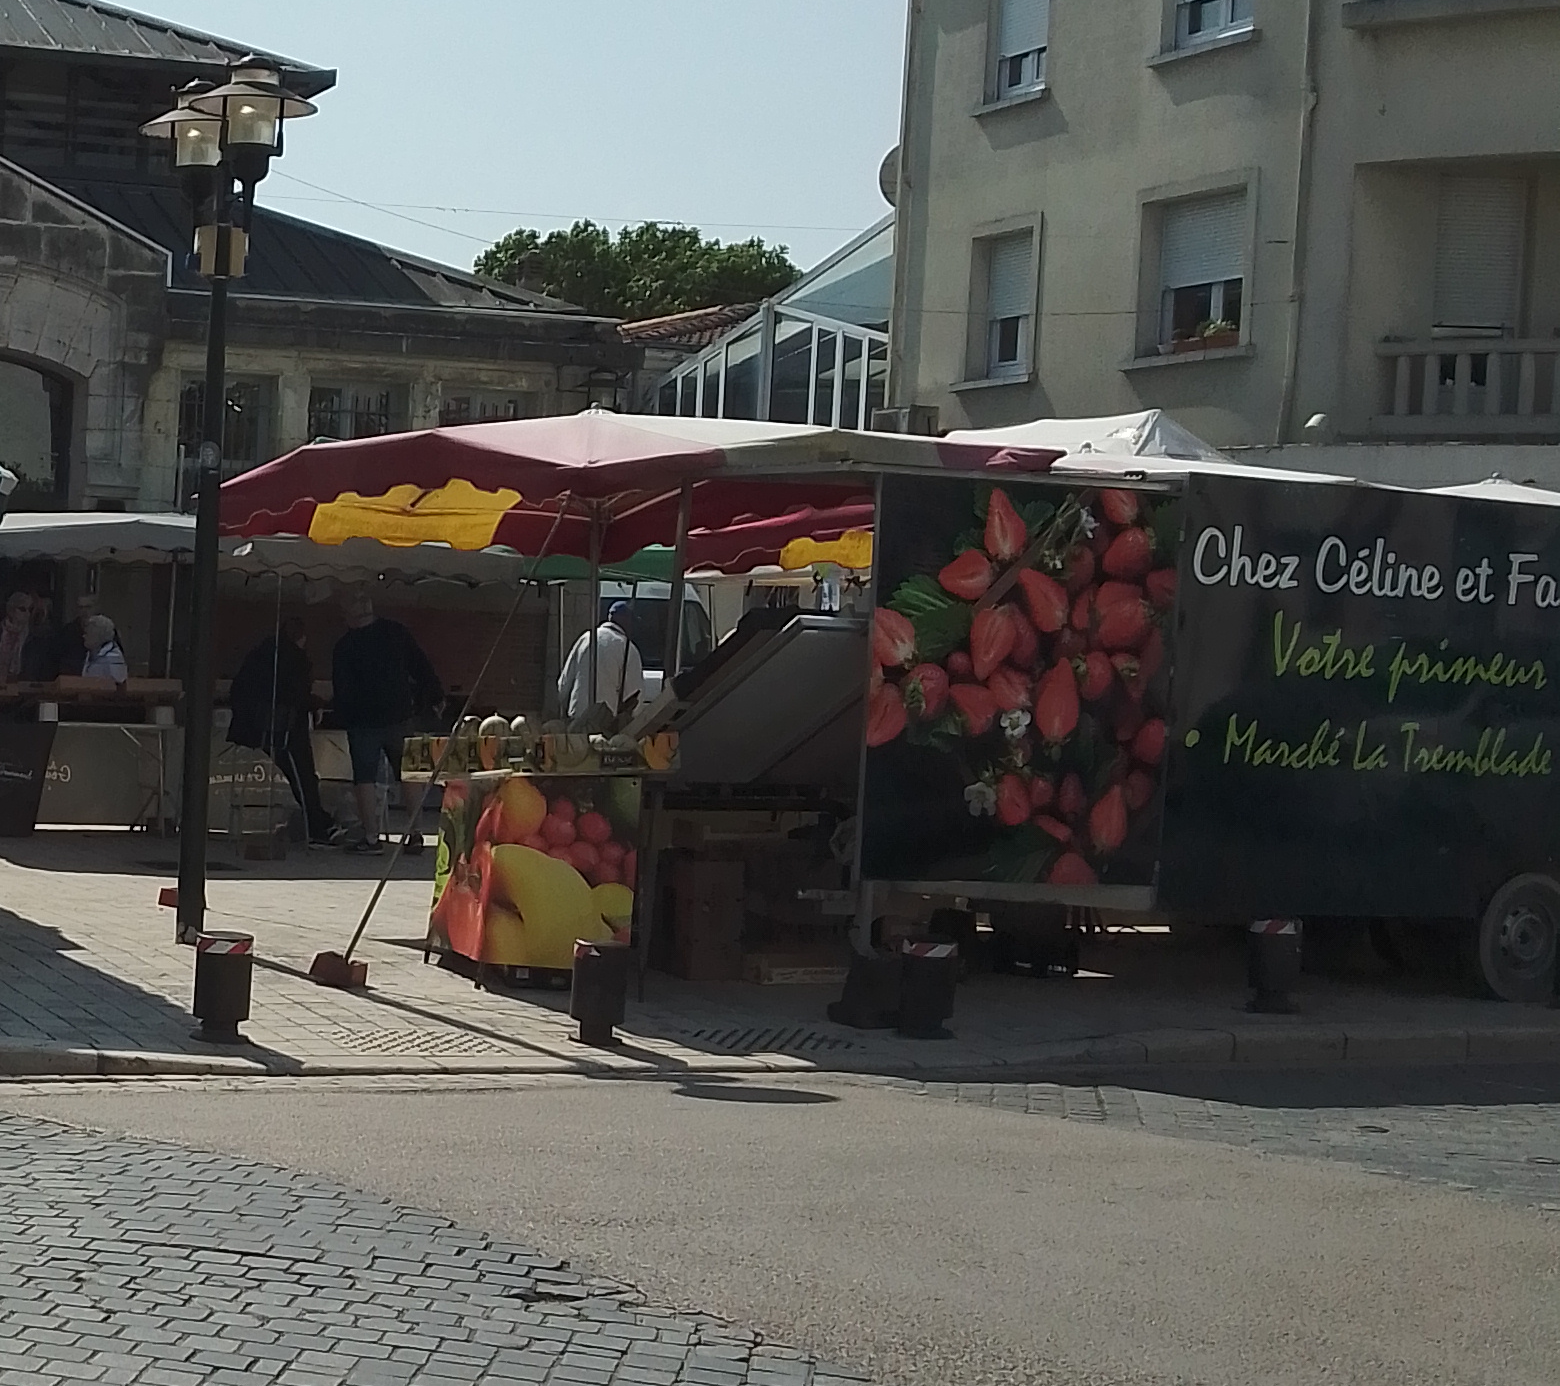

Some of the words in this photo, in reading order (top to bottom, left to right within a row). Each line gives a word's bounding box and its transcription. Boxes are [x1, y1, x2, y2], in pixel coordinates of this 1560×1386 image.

[1192, 523, 1301, 590] Chez
[1314, 534, 1445, 601] Céline
[1454, 556, 1496, 605] et
[1507, 552, 1560, 609] Fa
[1272, 608, 1377, 681] Votre
[1386, 637, 1549, 705] primeur
[1222, 711, 1347, 772] Marché
[1351, 719, 1389, 772] La
[1399, 720, 1553, 779] Tremblade
